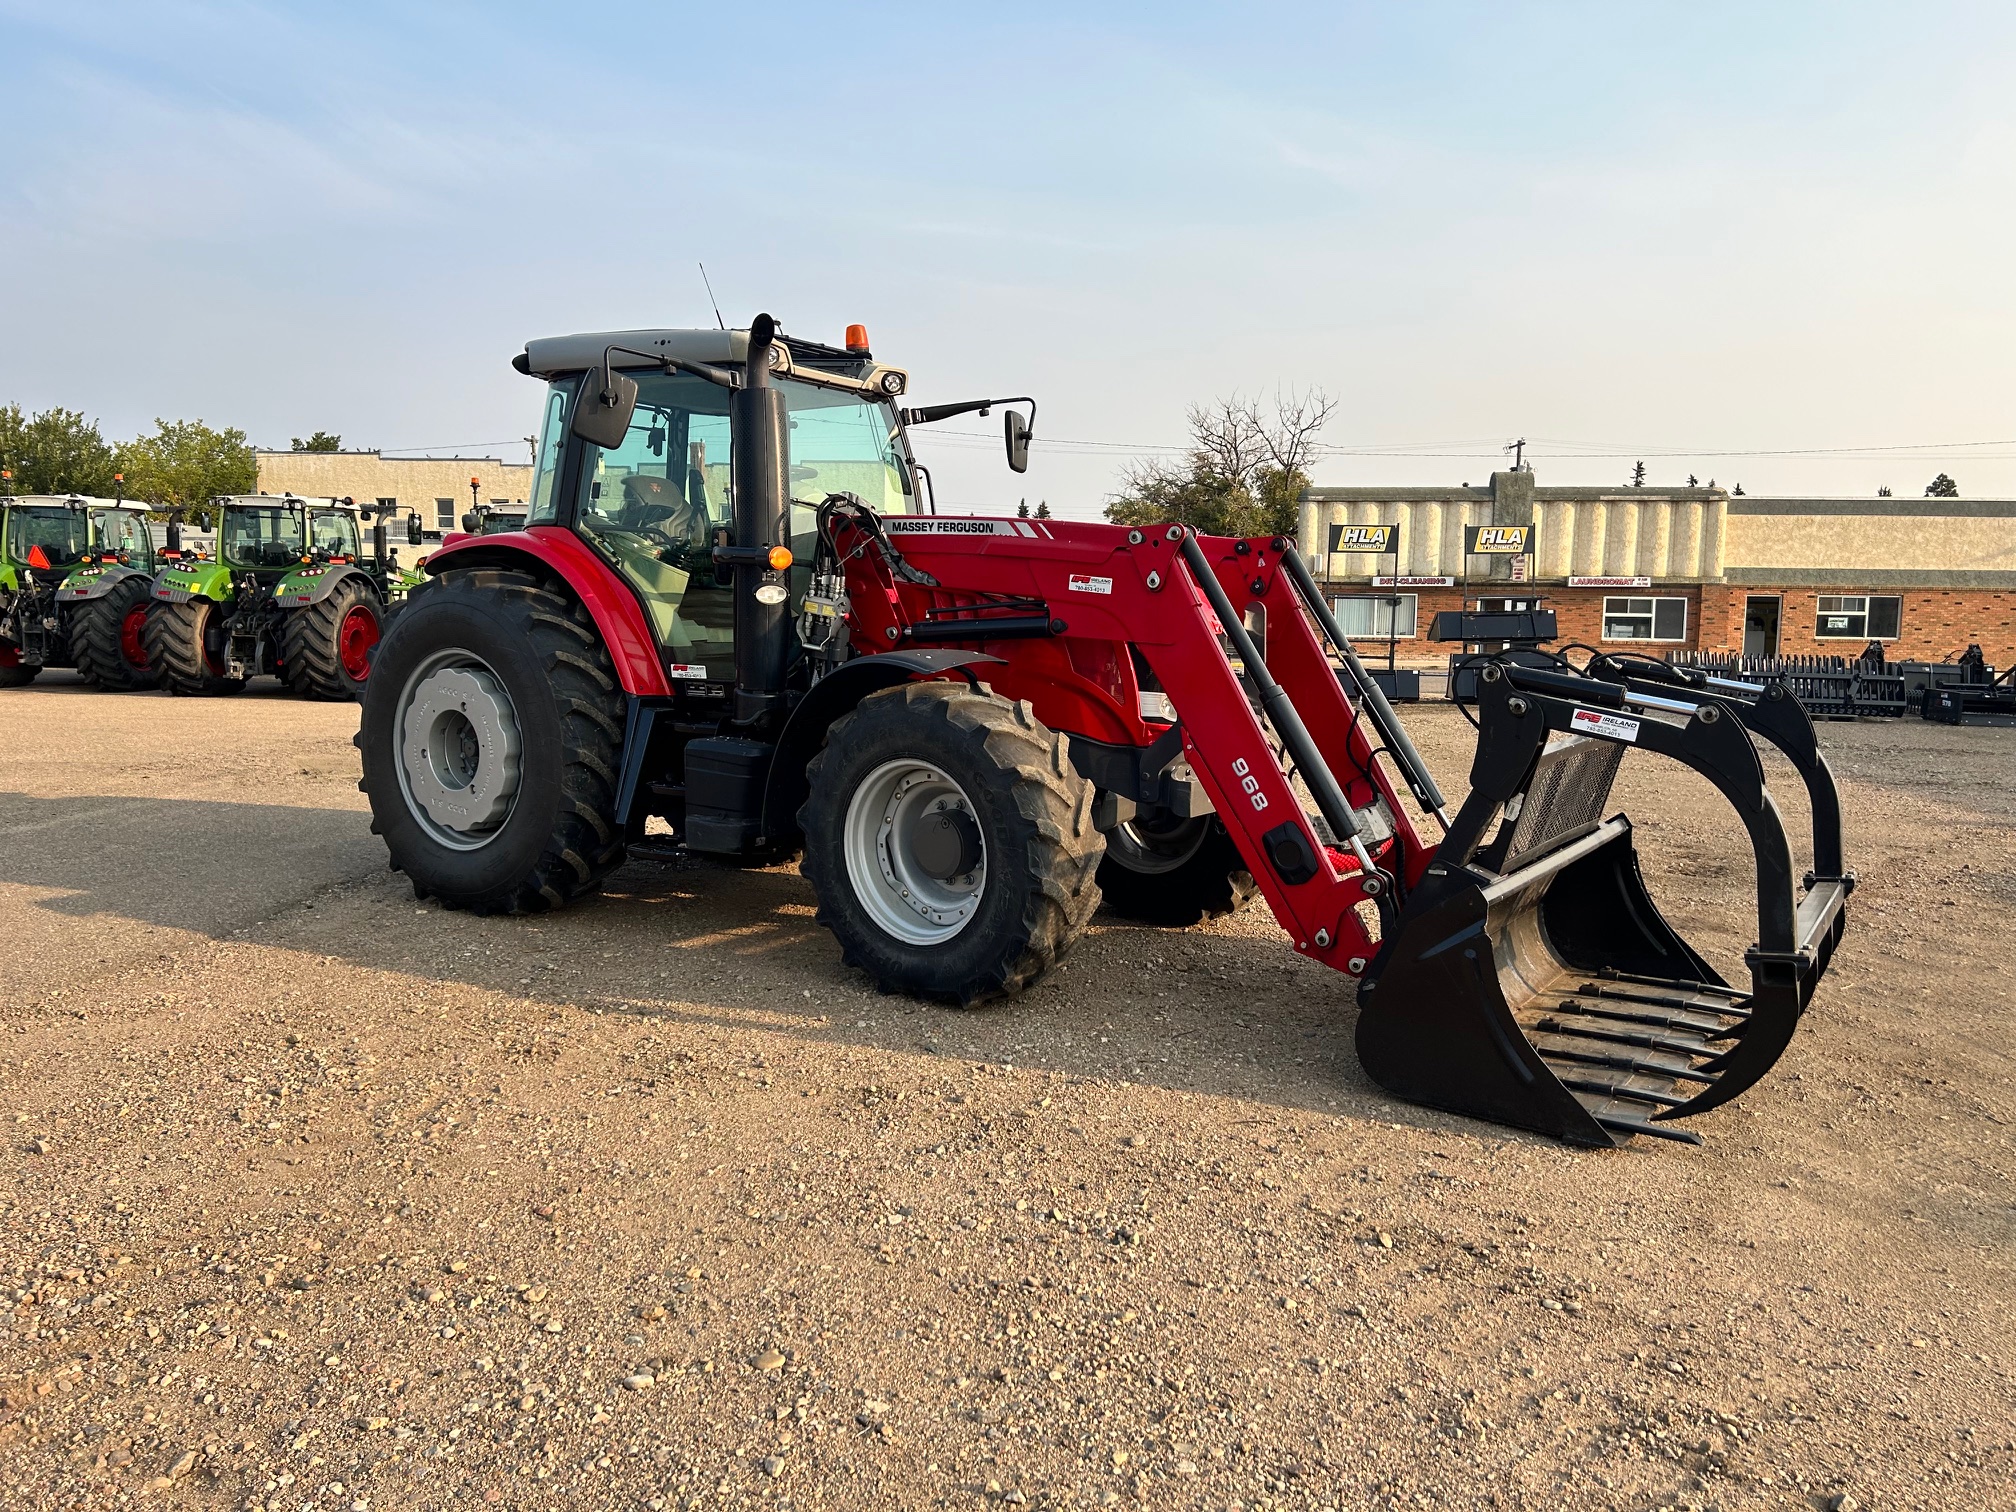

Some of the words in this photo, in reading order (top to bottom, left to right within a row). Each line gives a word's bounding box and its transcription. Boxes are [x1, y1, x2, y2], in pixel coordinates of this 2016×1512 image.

[892, 522, 934, 532] MASSEY
[938, 522, 994, 533] FERGUSON
[1343, 529, 1385, 543] HLA
[1480, 529, 1522, 544] HLA
[1570, 577, 1635, 586] LAUNDROMAT
[1602, 717, 1638, 728] IRELAND
[1231, 757, 1269, 811] 968
